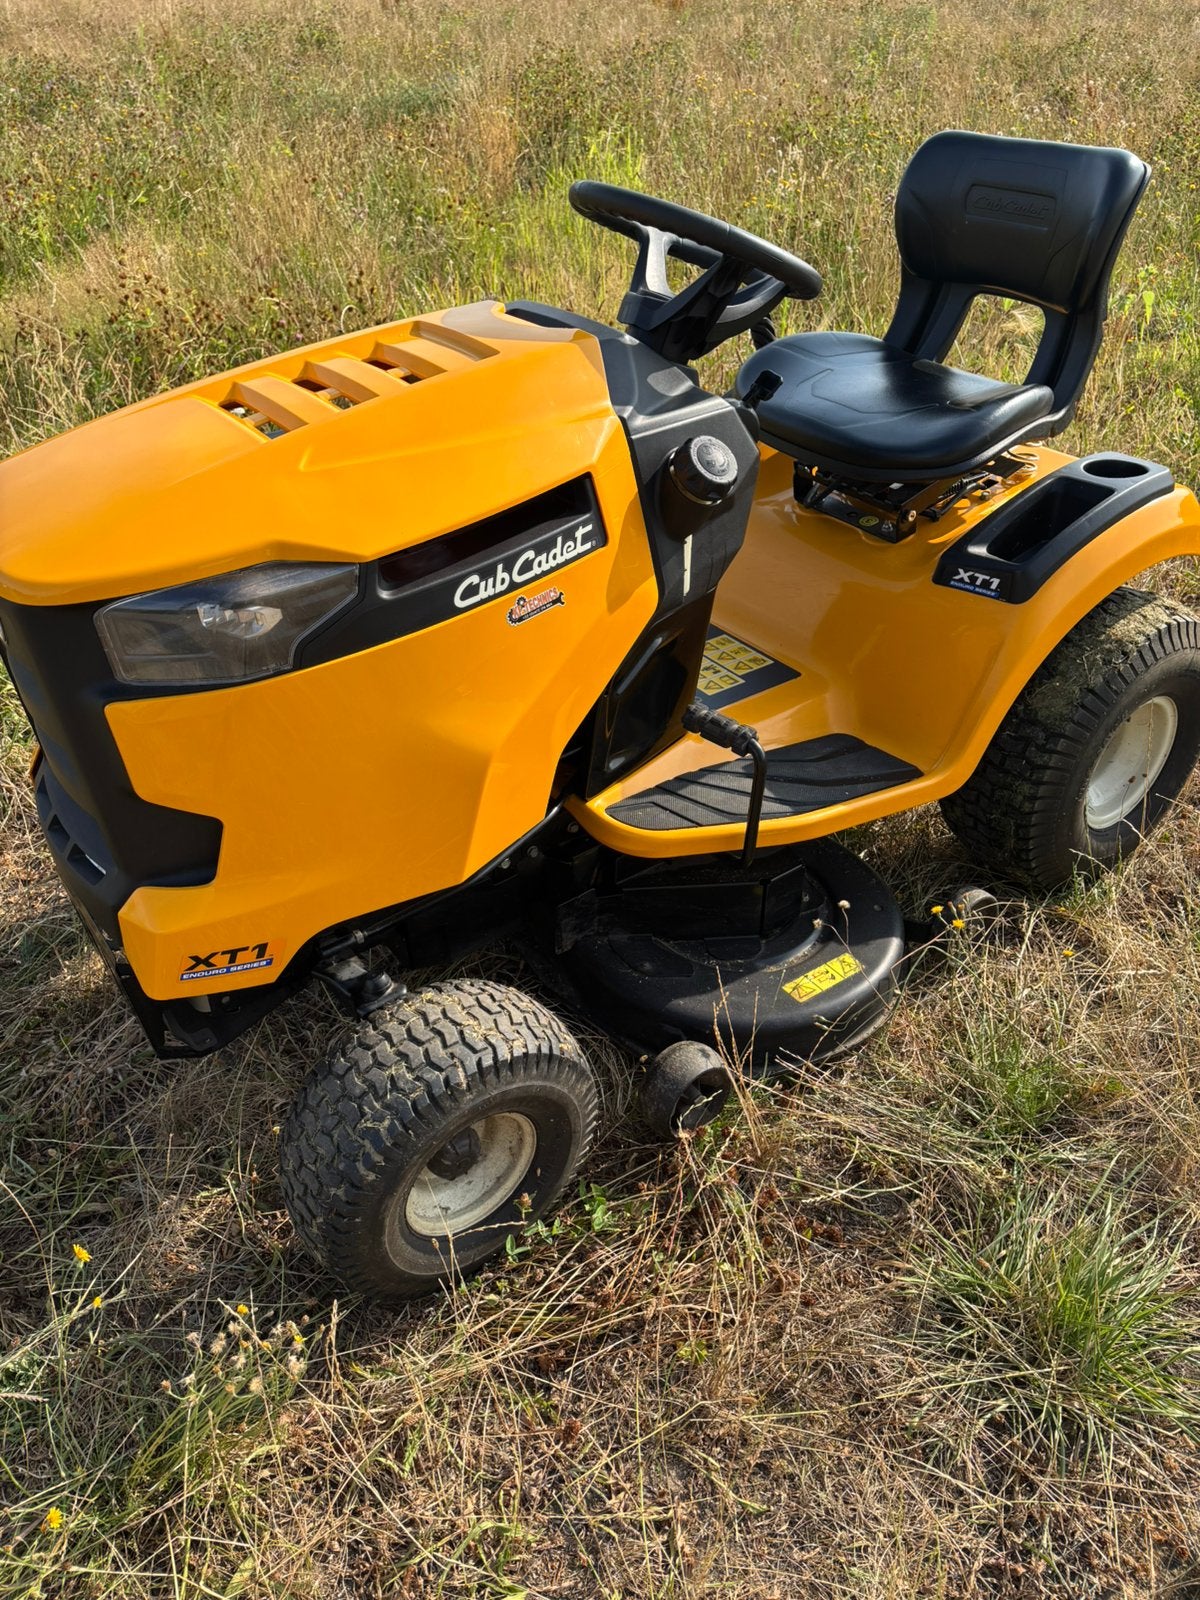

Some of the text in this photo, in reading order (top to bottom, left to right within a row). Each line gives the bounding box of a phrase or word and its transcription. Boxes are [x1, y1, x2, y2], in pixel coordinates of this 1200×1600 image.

[454, 524, 593, 608] Cub Cadet
[952, 568, 1001, 590] XT1
[183, 942, 269, 972] XT1
[182, 961, 268, 980] ENDURO SERIES
